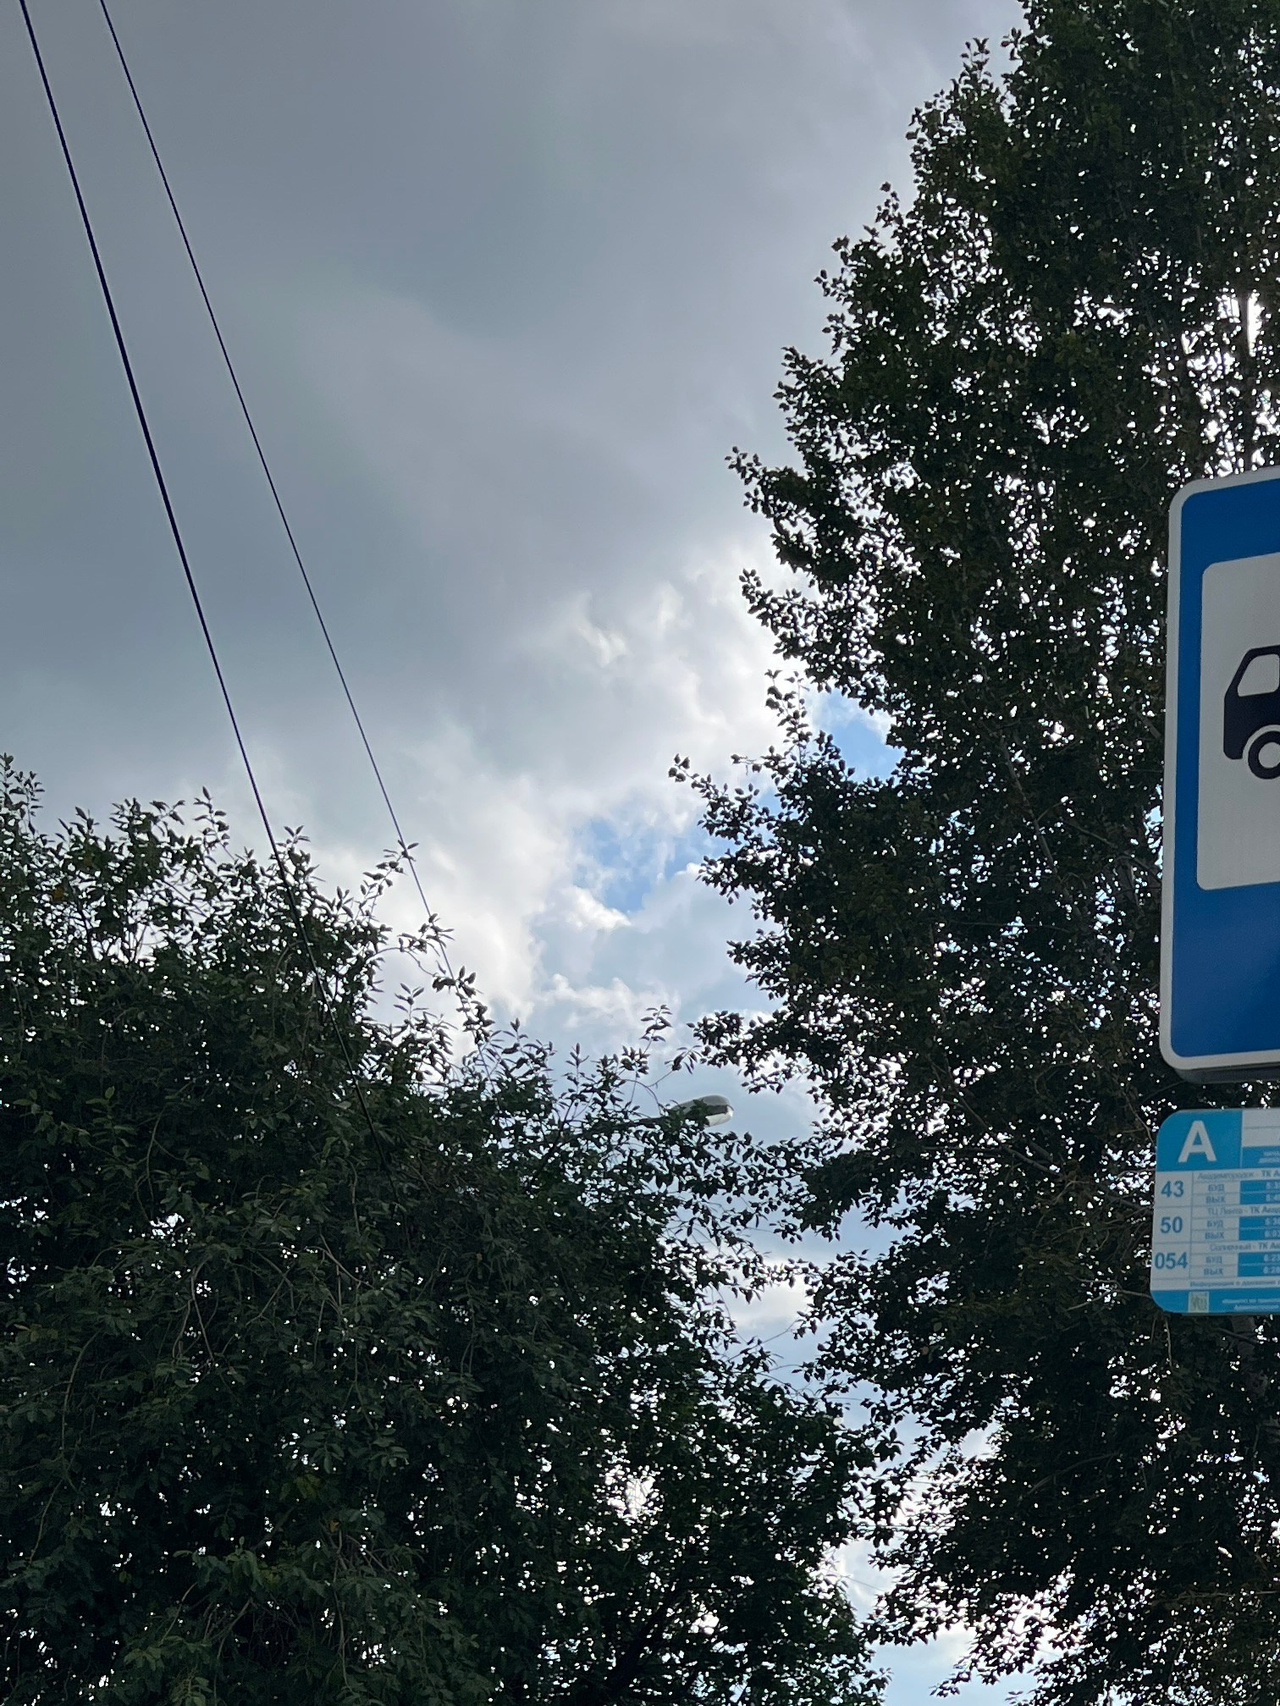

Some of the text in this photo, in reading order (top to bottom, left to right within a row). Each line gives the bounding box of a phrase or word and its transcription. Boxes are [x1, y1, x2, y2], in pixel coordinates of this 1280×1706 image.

[1160, 1180, 1184, 1198] 43
[1160, 1216, 1183, 1234] 50
[1154, 1252, 1189, 1270] 054
